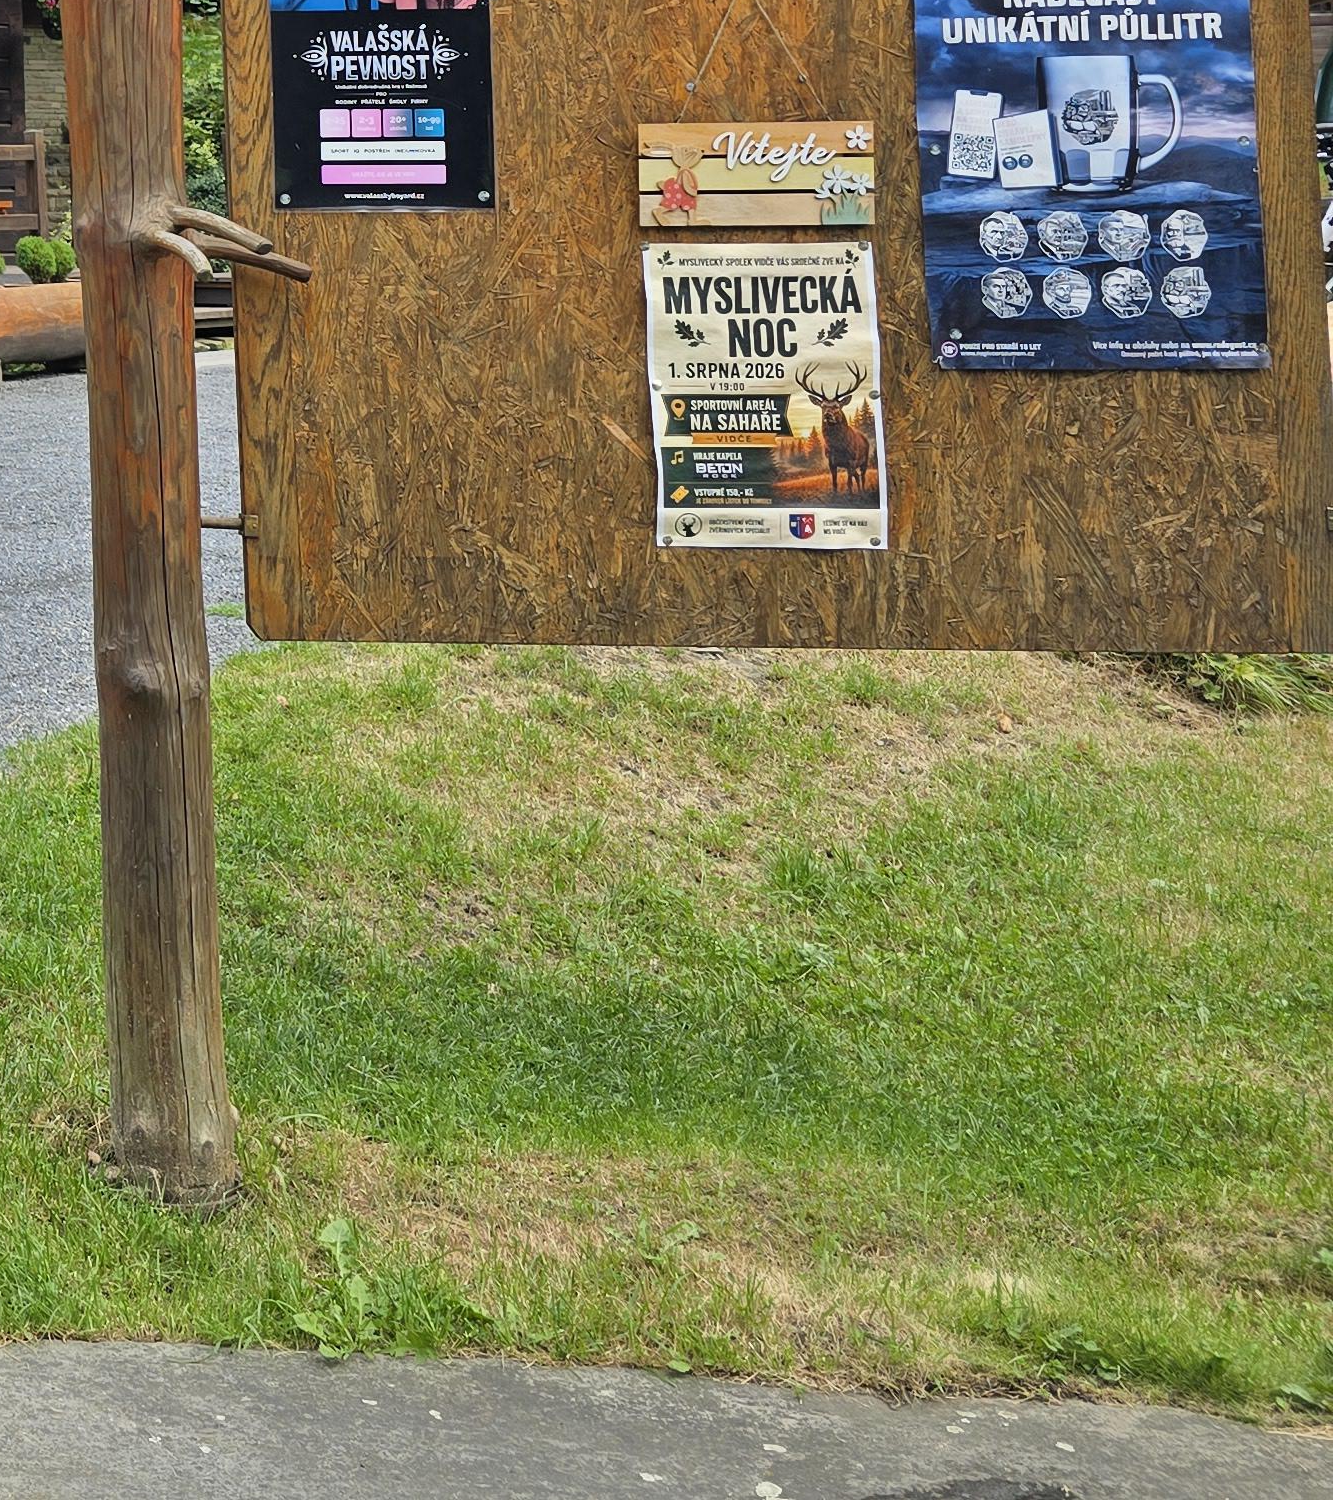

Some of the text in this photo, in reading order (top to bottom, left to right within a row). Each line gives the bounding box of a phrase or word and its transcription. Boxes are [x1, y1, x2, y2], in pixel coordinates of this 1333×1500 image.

[942, 8, 1222, 44] UNIKÁTNÍ PŮLLITR
[330, 24, 429, 52] VALAŠSKÁ
[331, 55, 429, 80] PEVNOST
[679, 257, 723, 266] MYSLIVECKÝ
[726, 258, 752, 266] SPOLEK
[754, 257, 774, 266] VIDČE
[776, 257, 789, 266] VÁS
[822, 257, 833, 265] ZVE
[662, 268, 862, 314] MYSLIVECKÁ
[728, 318, 797, 357] NOC
[668, 363, 784, 378] 1. SRPNA 2026
[719, 383, 745, 391] 19:00
[691, 398, 777, 411] SPORTOVNÍ AREÁL
[690, 411, 781, 431] NA SAHAŘE
[717, 434, 752, 442] VIDČE
[693, 452, 742, 460] HRAJE KAPELA
[696, 463, 743, 473] BETON
[694, 487, 724, 496] VSTUPNÉ
